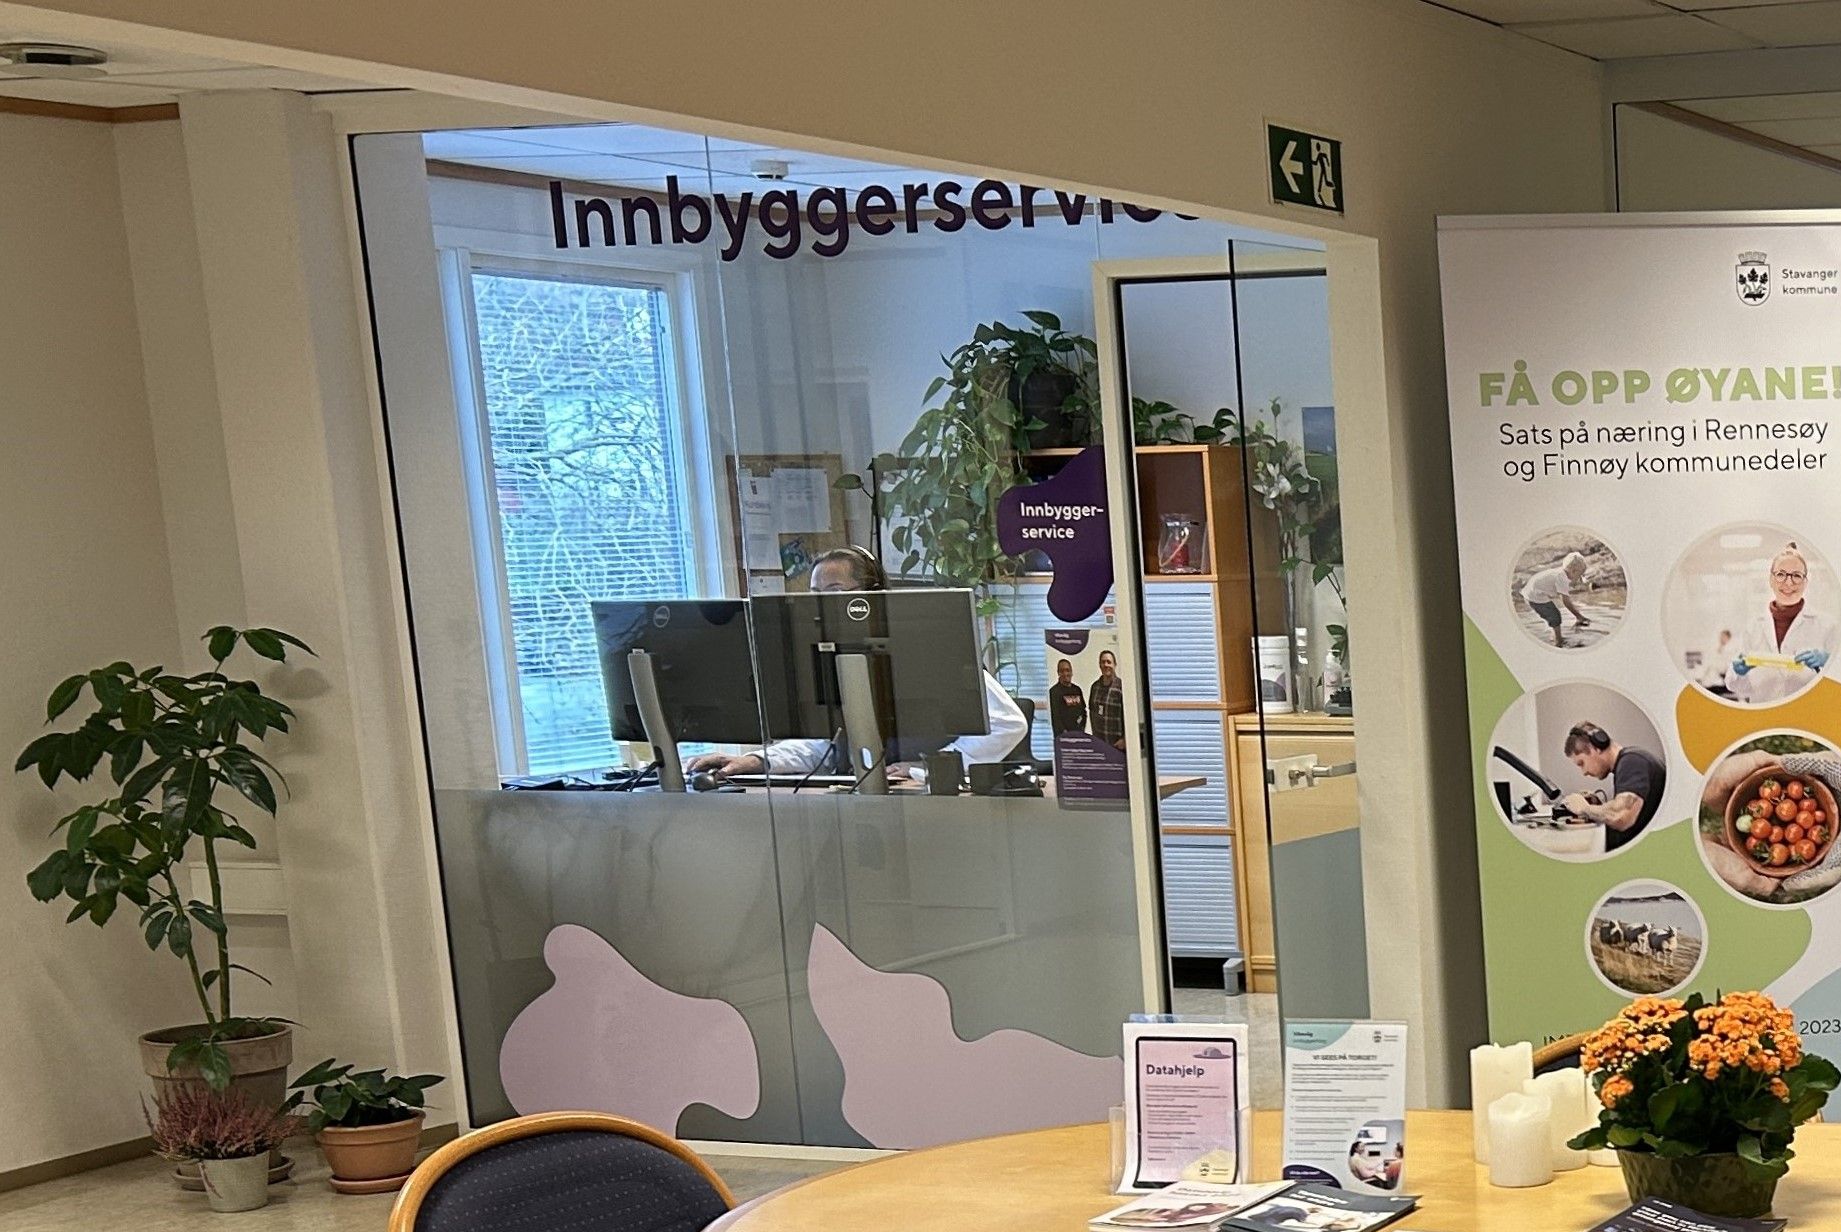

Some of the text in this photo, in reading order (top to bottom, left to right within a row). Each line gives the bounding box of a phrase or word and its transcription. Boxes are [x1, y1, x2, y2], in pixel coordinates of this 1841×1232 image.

[1782, 268, 1838, 281] Stavanger
[1782, 285, 1838, 295] kommune
[1479, 359, 1540, 407] FÅ
[1552, 370, 1651, 405] OPP
[1500, 419, 1828, 450] Sats på næring i Rennesøy
[1504, 448, 1827, 482] og Finnøy kommunedeler
[1020, 502, 1104, 520] Innbygger-
[1022, 524, 1075, 539] service
[1800, 1019, 1841, 1034] 2023
[1146, 1064, 1205, 1078] Datahjelp
